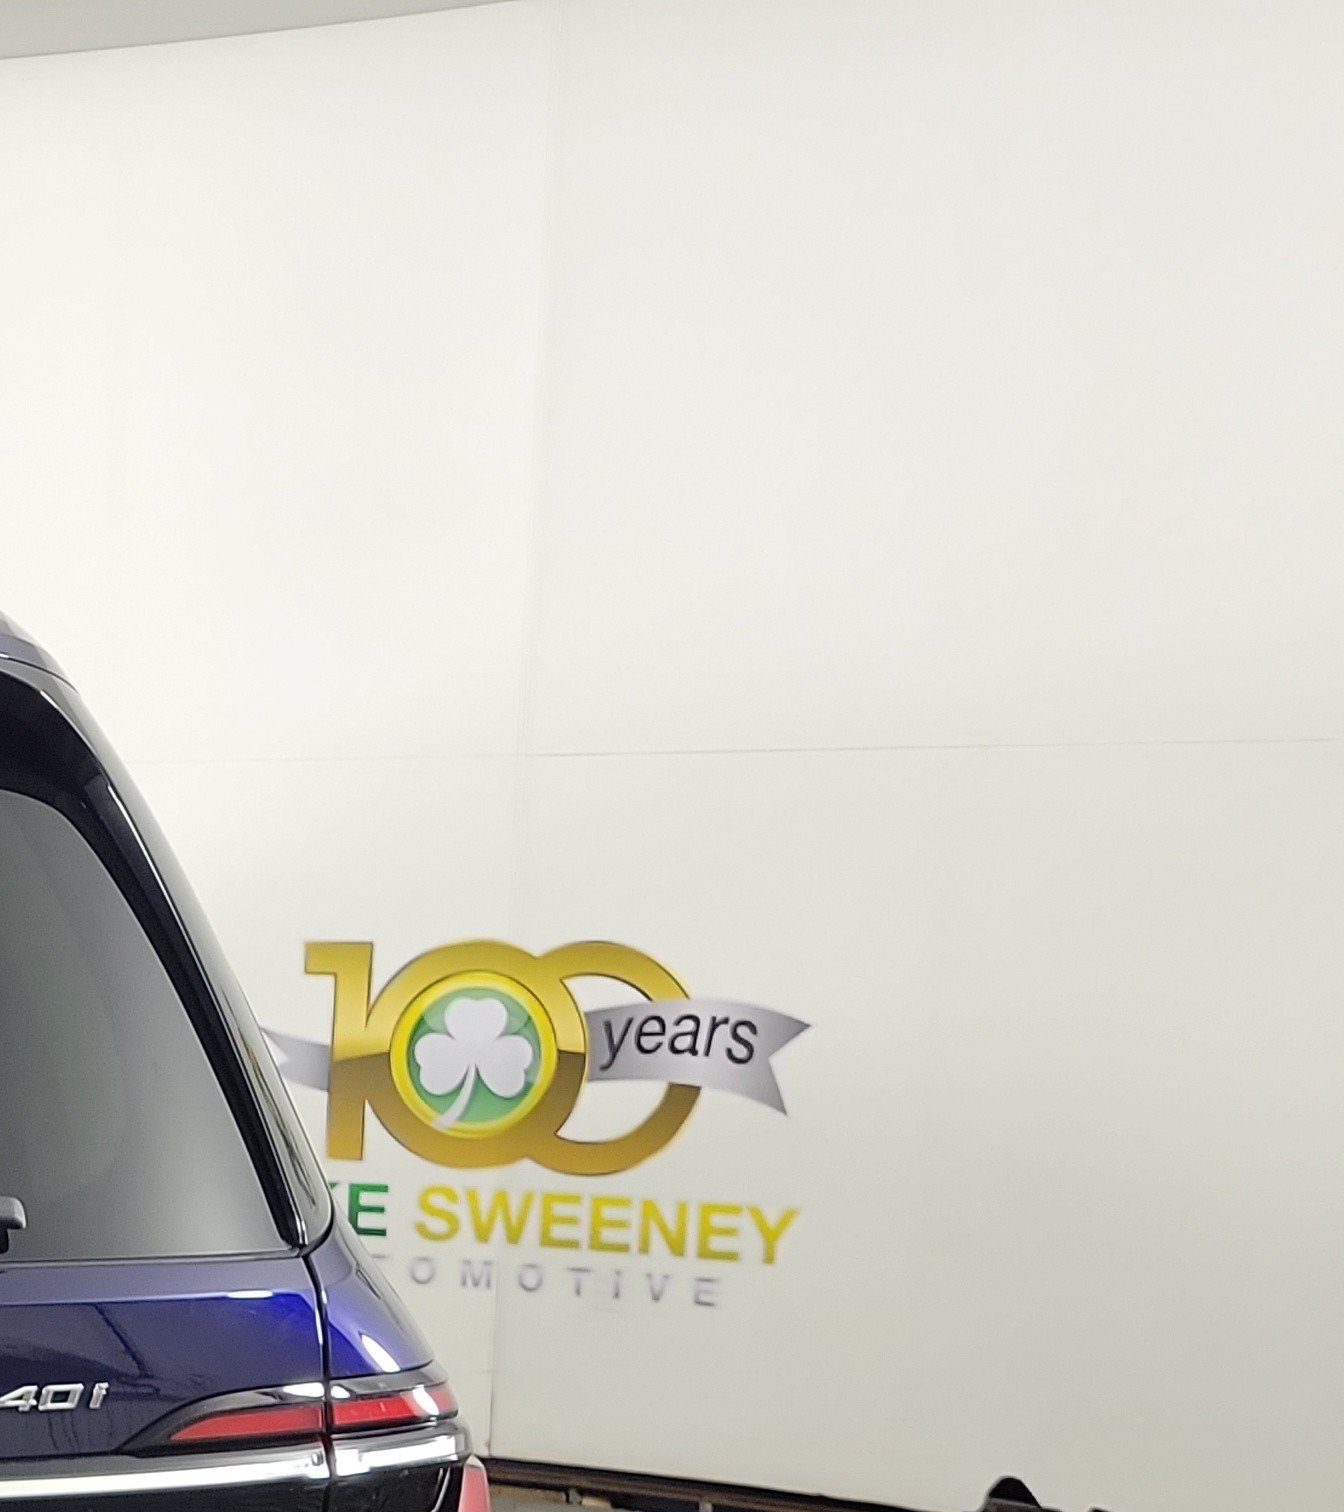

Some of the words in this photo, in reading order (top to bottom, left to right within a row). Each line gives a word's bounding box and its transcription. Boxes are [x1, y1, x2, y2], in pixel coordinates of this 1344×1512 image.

[304, 939, 701, 1177] 100
[599, 1012, 758, 1070] years
[414, 1184, 798, 1266] SWEENEY
